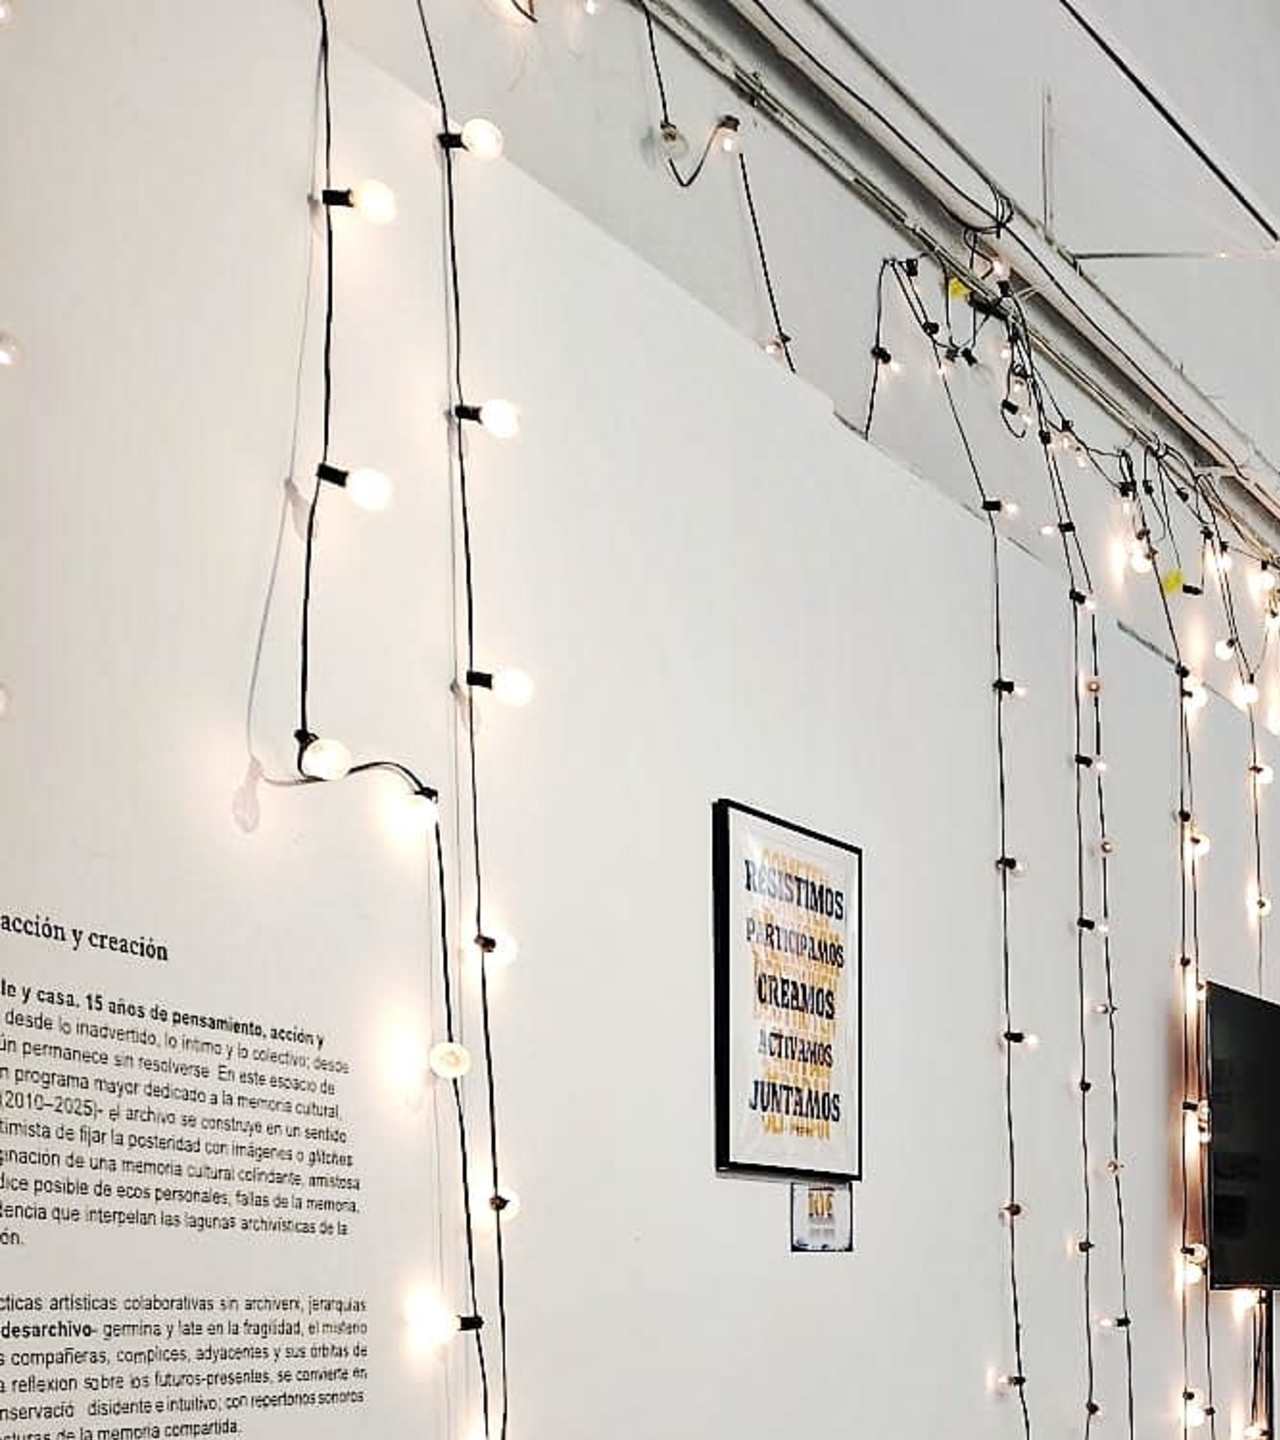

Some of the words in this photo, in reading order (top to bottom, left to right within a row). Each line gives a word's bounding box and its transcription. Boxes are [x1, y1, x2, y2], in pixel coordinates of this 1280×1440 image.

[1, 914, 66, 942] acción
[88, 931, 169, 961] creación
[86, 993, 103, 1011] 15
[108, 998, 145, 1019] años
[150, 1003, 168, 1022] de
[757, 973, 835, 1020] CREAMOS
[5, 1008, 53, 1030] desde
[23, 1039, 108, 1066] permanece
[218, 1064, 235, 1082] En
[758, 1031, 834, 1068] ACTIVAMOS
[15, 1068, 89, 1089] programa
[749, 1079, 841, 1122] JUNTAMOS
[56, 1121, 75, 1141] de
[111, 1128, 124, 1145] la
[65, 1152, 85, 1169] de
[90, 1156, 117, 1173] una
[34, 1176, 89, 1197] posible
[94, 1178, 112, 1197] de
[51, 1204, 80, 1223] que
[207, 1322, 224, 1336] en
[11, 1346, 111, 1369] compañeras,
[84, 1375, 124, 1392] sobre
